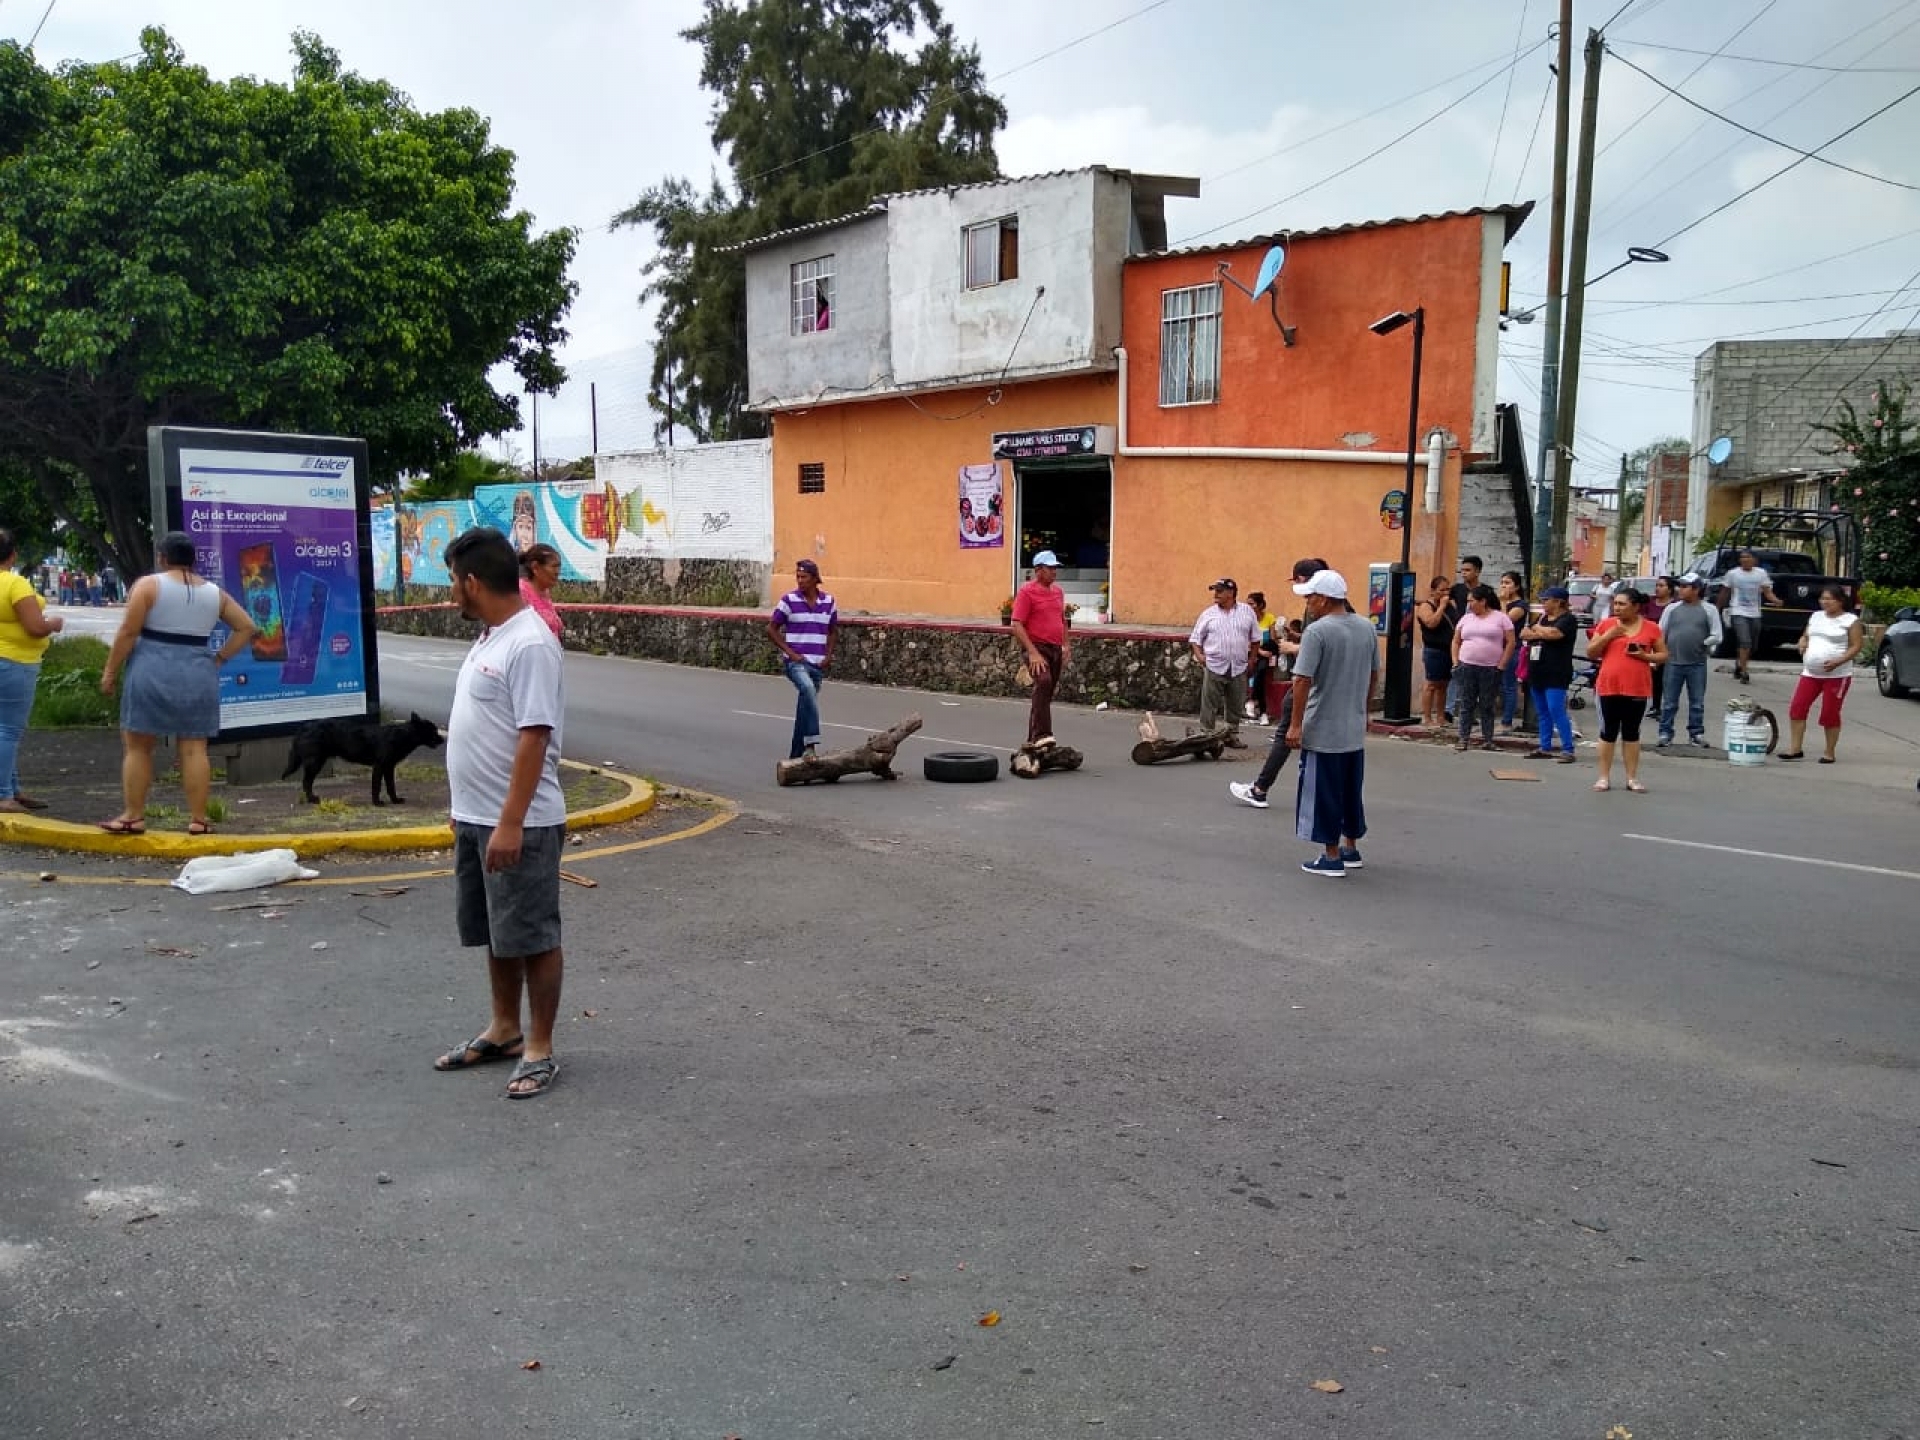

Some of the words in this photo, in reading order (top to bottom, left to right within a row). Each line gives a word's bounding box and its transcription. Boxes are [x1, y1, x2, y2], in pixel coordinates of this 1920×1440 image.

[1054, 432, 1079, 443] STUDIO
[314, 457, 350, 471] telcel
[309, 485, 349, 499] alcatel
[191, 508, 209, 520] Así
[211, 509, 225, 520] de
[226, 509, 287, 522] Excepcional
[294, 544, 341, 557] alcatel
[342, 540, 352, 558] 3
